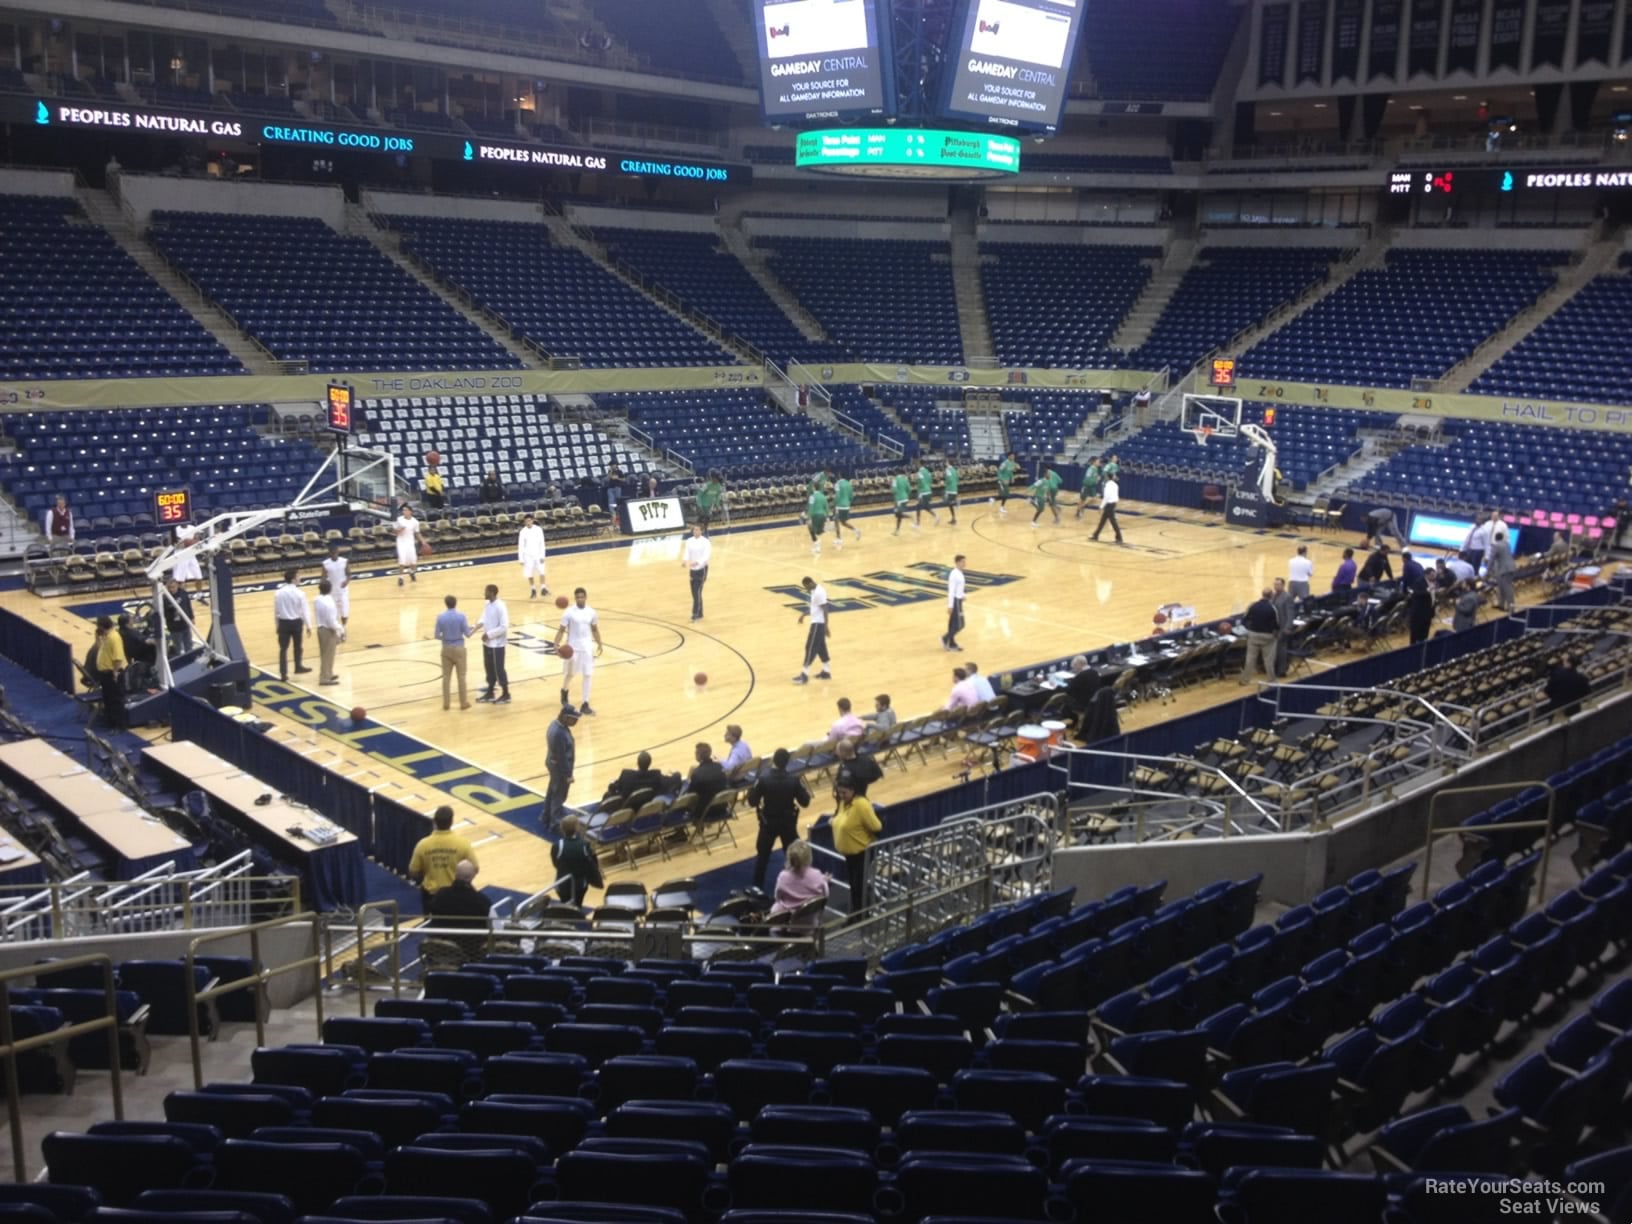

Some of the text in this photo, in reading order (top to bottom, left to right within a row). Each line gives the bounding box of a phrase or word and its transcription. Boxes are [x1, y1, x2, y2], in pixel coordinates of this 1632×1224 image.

[771, 56, 869, 77] GAMEDAY CENTRAL
[968, 59, 1056, 86] GAMEDAY CENTRAL
[792, 78, 849, 91] YOUR SOURCE FOR
[984, 84, 1036, 99] YOUR SOURCE FOR
[779, 88, 865, 103] ALL GAMEDAY INFORMATION
[968, 92, 1046, 111] ALL GAMEDAY INFORMATION
[60, 107, 242, 136] PEOPLES NATURAL GAS
[263, 126, 414, 152] CREATING GOOD JOBS
[480, 146, 606, 170] PEOPLES NATURAL GAS
[620, 160, 728, 181] CREATING GOOD JOBS
[1392, 172, 1433, 182] MAN 0
[1391, 183, 1410, 193] PITT
[1424, 183, 1432, 192] 0
[1527, 174, 1592, 187] PEOPLES
[372, 376, 523, 391] THE OAKLAND ZOO
[1215, 368, 1231, 383] 35
[332, 401, 347, 426] 35
[1502, 402, 1553, 420] HAIL
[1565, 406, 1598, 424] TO
[158, 492, 186, 507] 60:00
[163, 505, 182, 519] 35
[638, 501, 669, 521] PITT
